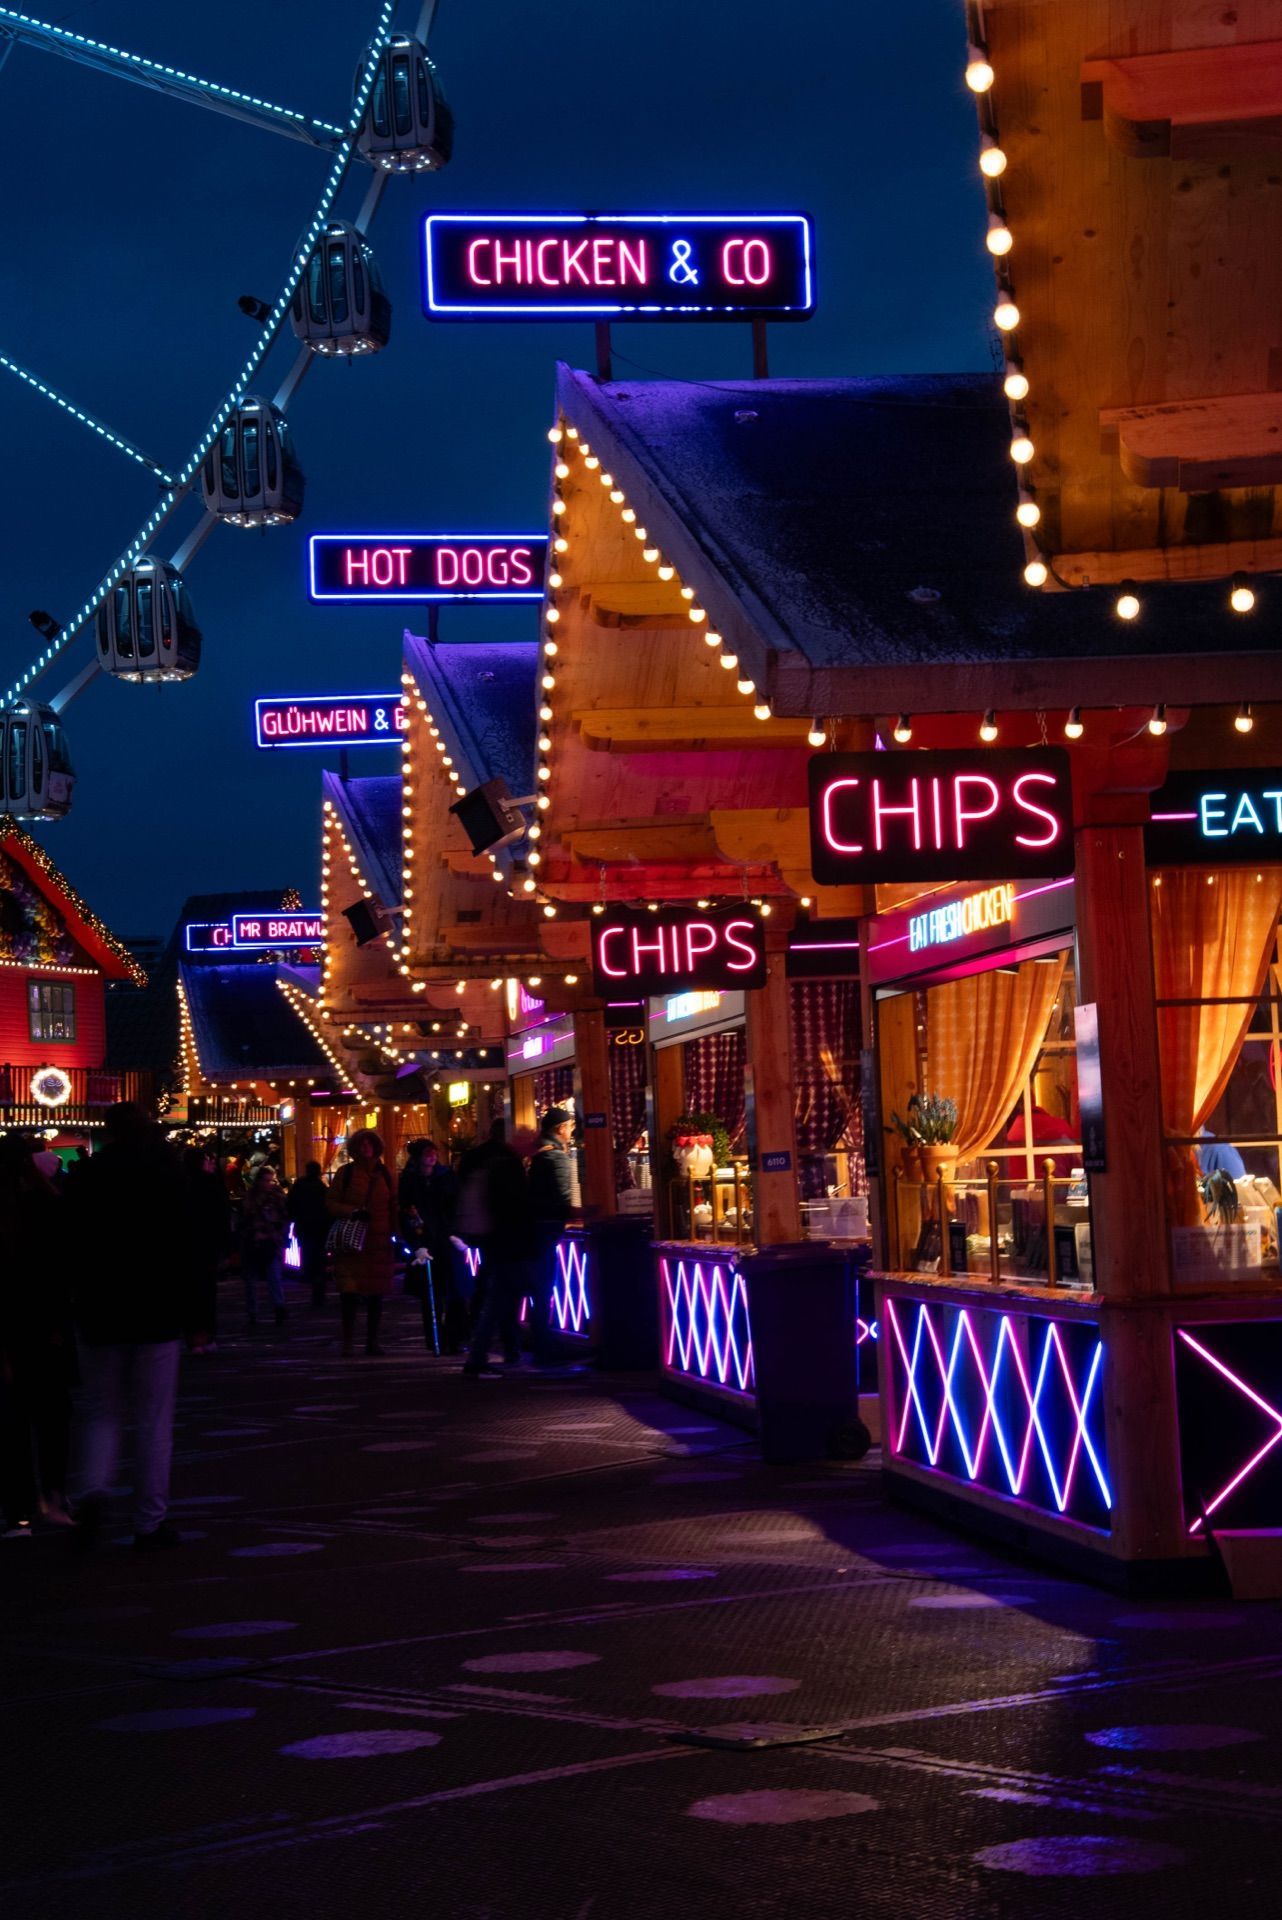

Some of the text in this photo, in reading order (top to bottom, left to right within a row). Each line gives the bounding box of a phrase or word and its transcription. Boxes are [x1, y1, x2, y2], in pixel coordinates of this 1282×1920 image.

[468, 239, 771, 285] CHICKEN & CO
[346, 548, 532, 585] HOT DOGS
[262, 706, 367, 735] GLÜHWEIN
[374, 708, 389, 731] &
[823, 773, 1059, 852] CHIPS
[1200, 791, 1282, 836] EAT
[240, 922, 261, 938] MR
[909, 883, 1014, 952] EAT FRESH CHICKEN
[599, 921, 757, 976] CHIPS
